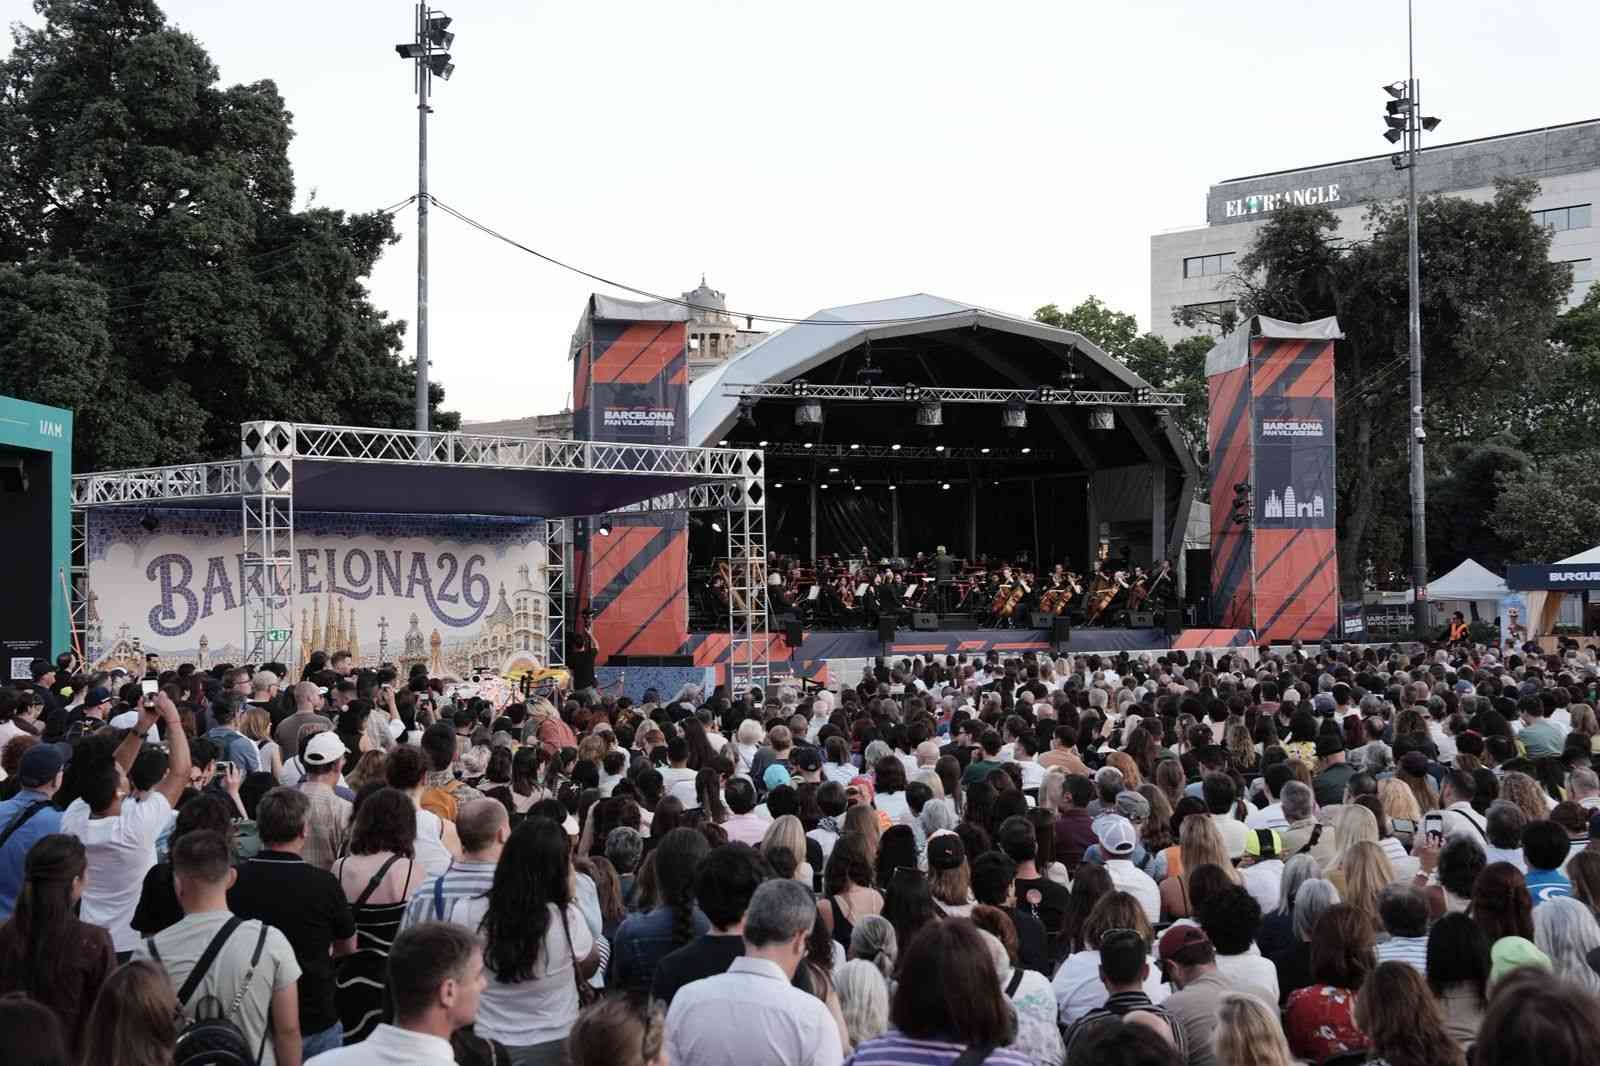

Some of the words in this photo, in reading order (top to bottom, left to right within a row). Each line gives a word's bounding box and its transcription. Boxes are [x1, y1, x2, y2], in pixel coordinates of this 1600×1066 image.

[1226, 200, 1246, 217] EL
[604, 411, 674, 420] BARCELONA
[1263, 422, 1323, 431] BARCELONA
